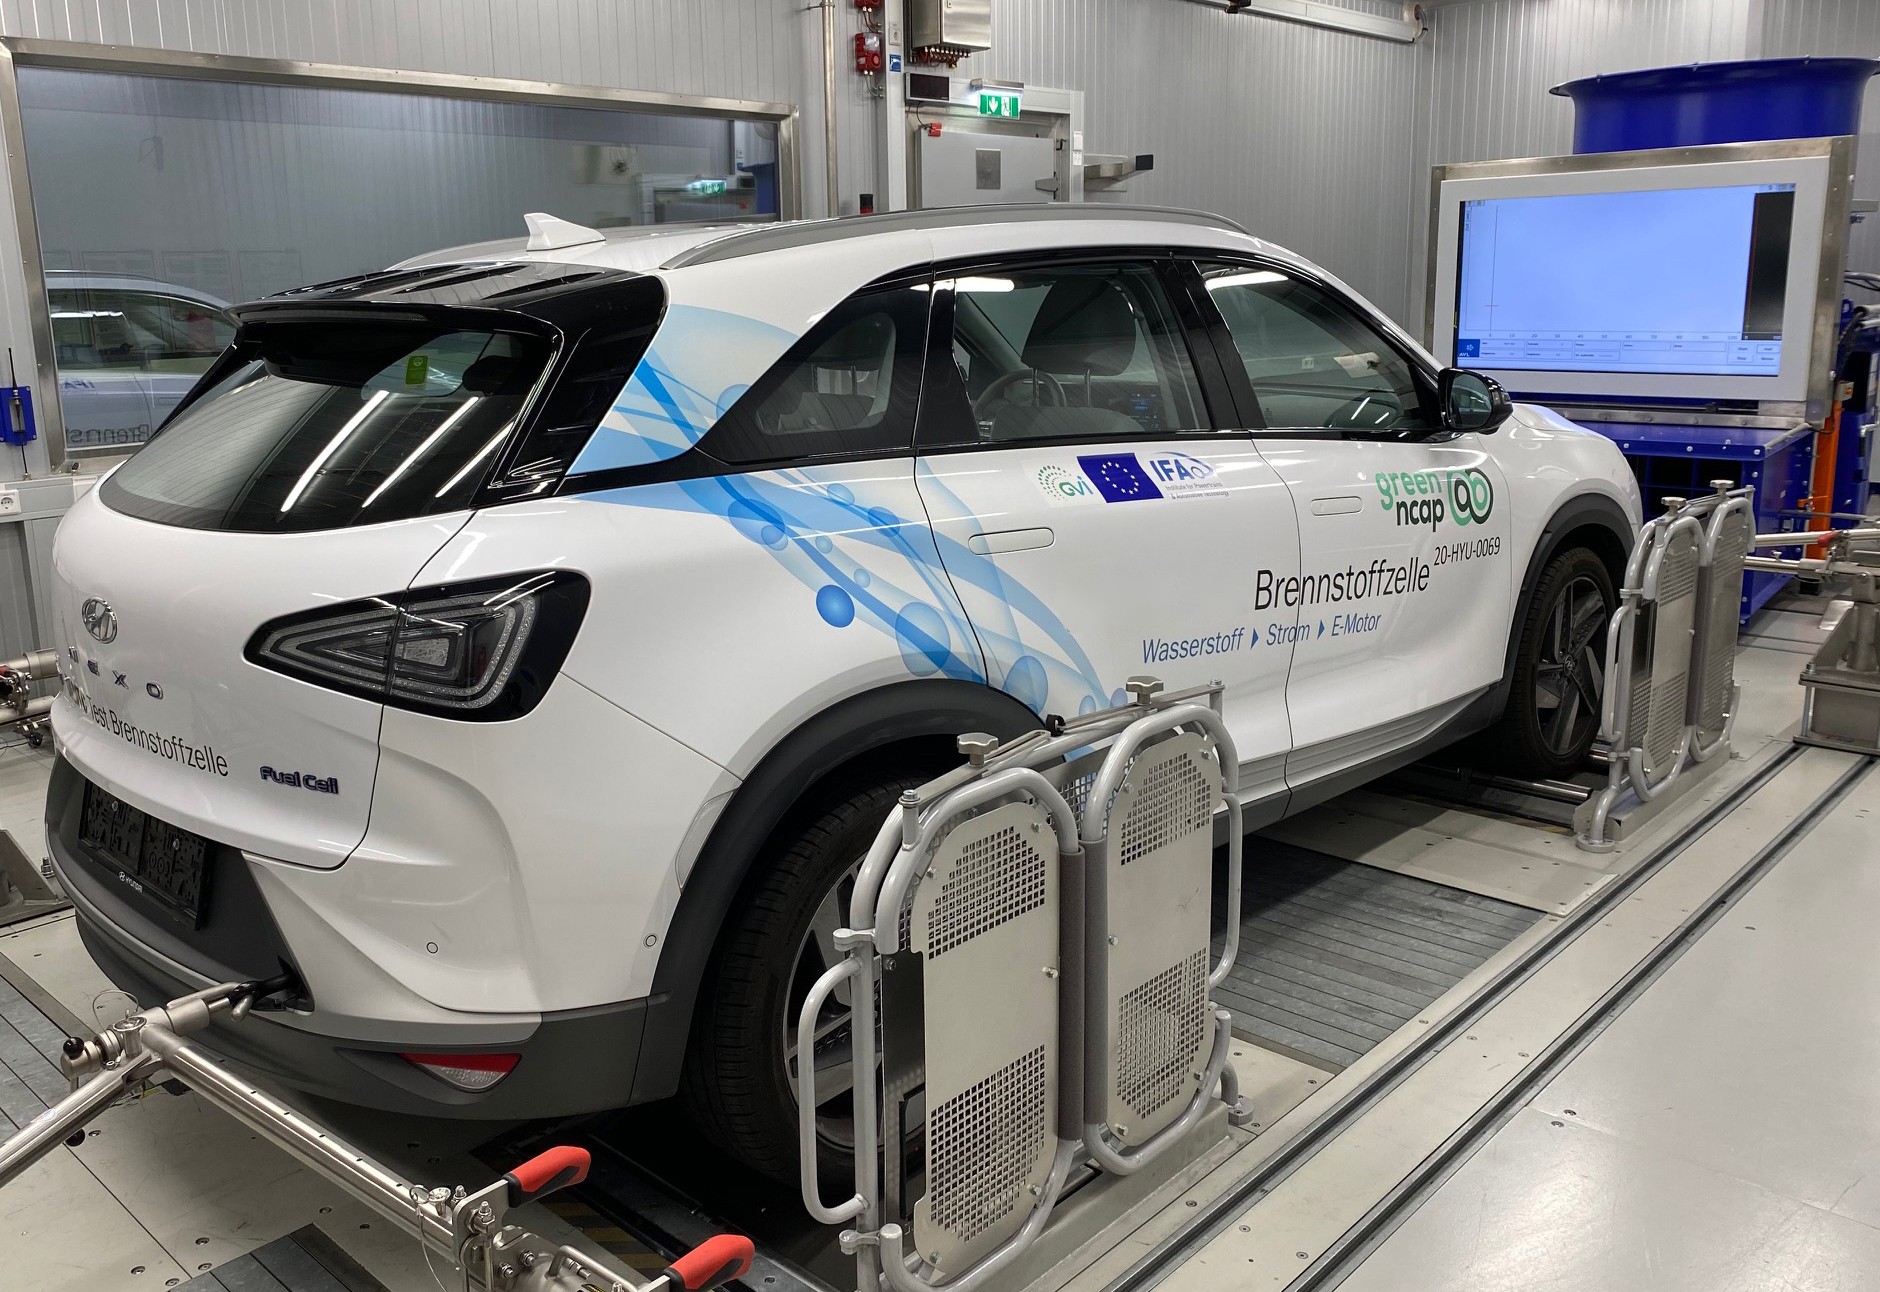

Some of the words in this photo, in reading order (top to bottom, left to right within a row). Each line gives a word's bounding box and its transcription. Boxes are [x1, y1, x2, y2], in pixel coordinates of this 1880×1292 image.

[1375, 472, 1442, 510] green
[1396, 498, 1444, 532] ncap
[1433, 536, 1500, 566] 20-HYU-0069
[1254, 557, 1431, 610] Brennstoffzelle
[1142, 627, 1245, 664] Wasserstoff
[1266, 622, 1311, 646] Strom
[1331, 612, 1382, 637] E-Motor
[86, 694, 111, 732] Test
[109, 709, 229, 777] Brennstoffzelle
[260, 765, 302, 787] Fuel
[302, 774, 339, 794] Cell
